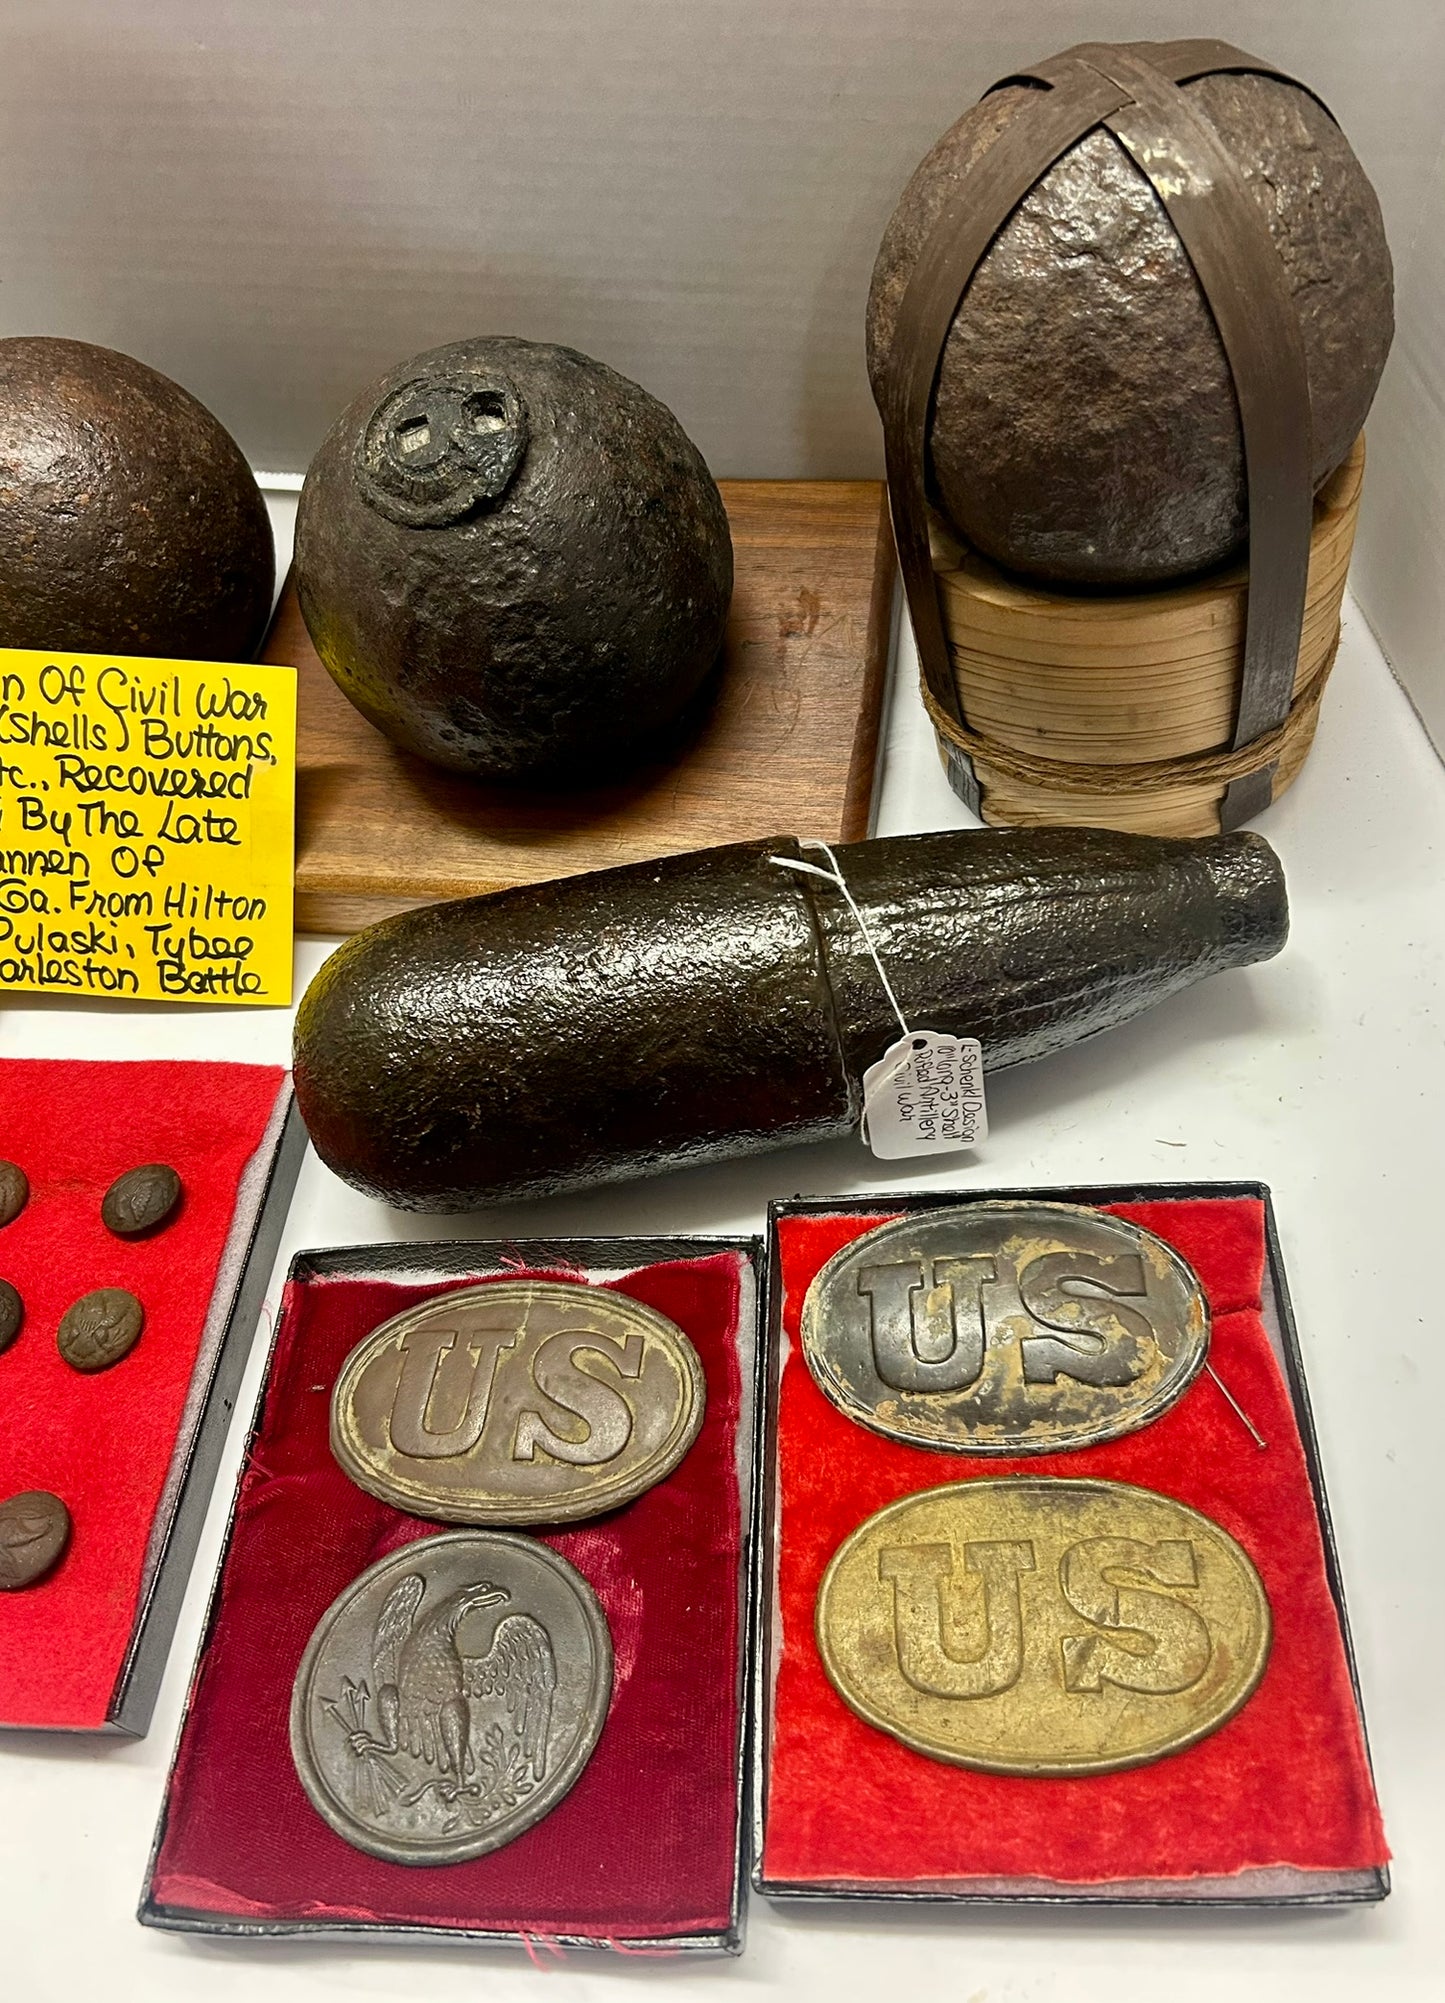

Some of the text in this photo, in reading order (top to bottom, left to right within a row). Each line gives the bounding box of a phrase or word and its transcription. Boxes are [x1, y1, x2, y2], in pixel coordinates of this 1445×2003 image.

[39, 665, 85, 706] Of
[97, 667, 180, 717] Civil
[196, 677, 268, 720] War
[141, 718, 277, 766] Buttons,
[54, 754, 254, 799] Recovered
[17, 796, 72, 847] By
[77, 800, 144, 838] The
[158, 800, 242, 845] Late
[111, 844, 165, 878] Of
[0, 878, 267, 921] Ga. From Hilton
[0, 915, 255, 966] Pulaski, Tybee
[157, 959, 269, 997] Battle
[896, 1092, 920, 1122] War
[941, 1108, 961, 1140] Shell
[960, 1101, 983, 1142] Design
[857, 1251, 1160, 1395] US
[389, 1328, 646, 1466] US
[877, 1535, 1213, 1701] US
